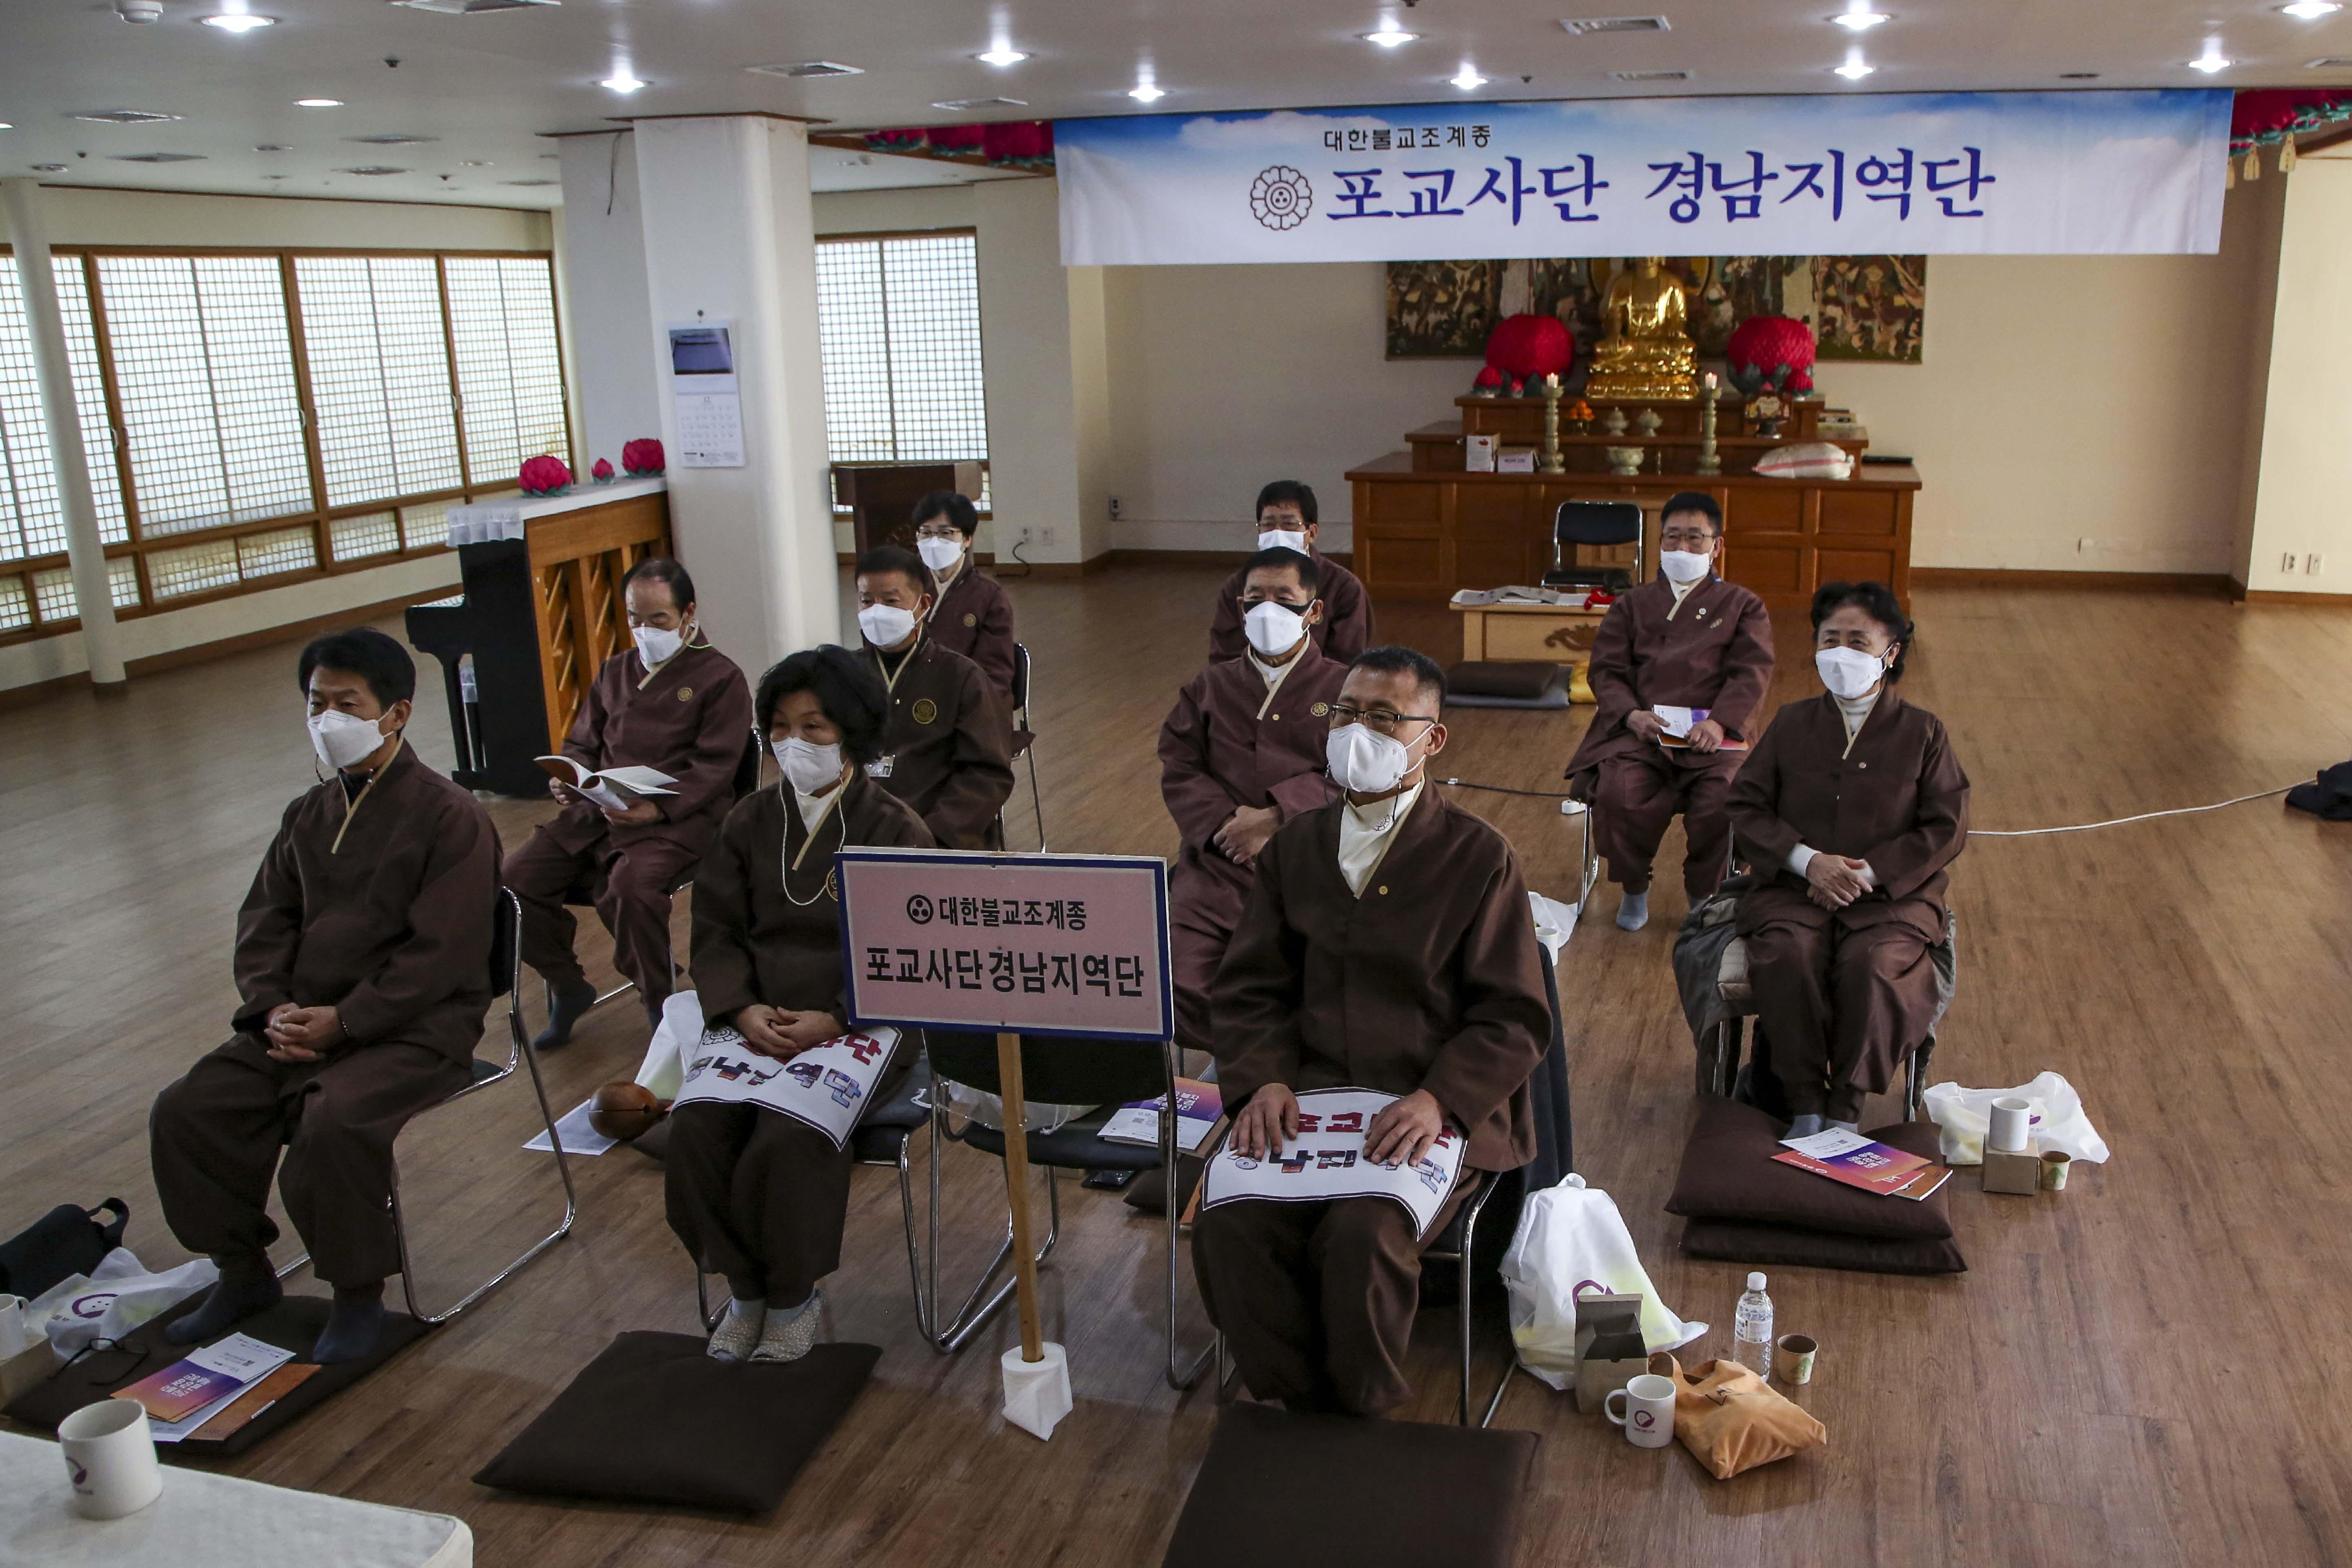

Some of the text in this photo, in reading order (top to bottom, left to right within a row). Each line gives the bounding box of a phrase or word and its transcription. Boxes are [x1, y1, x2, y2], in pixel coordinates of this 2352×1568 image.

[1324, 125, 1492, 151] 대한불교조계종
[1326, 147, 1996, 226] 포교사단 경남지역단
[939, 895, 1087, 931] 대한불교조계종
